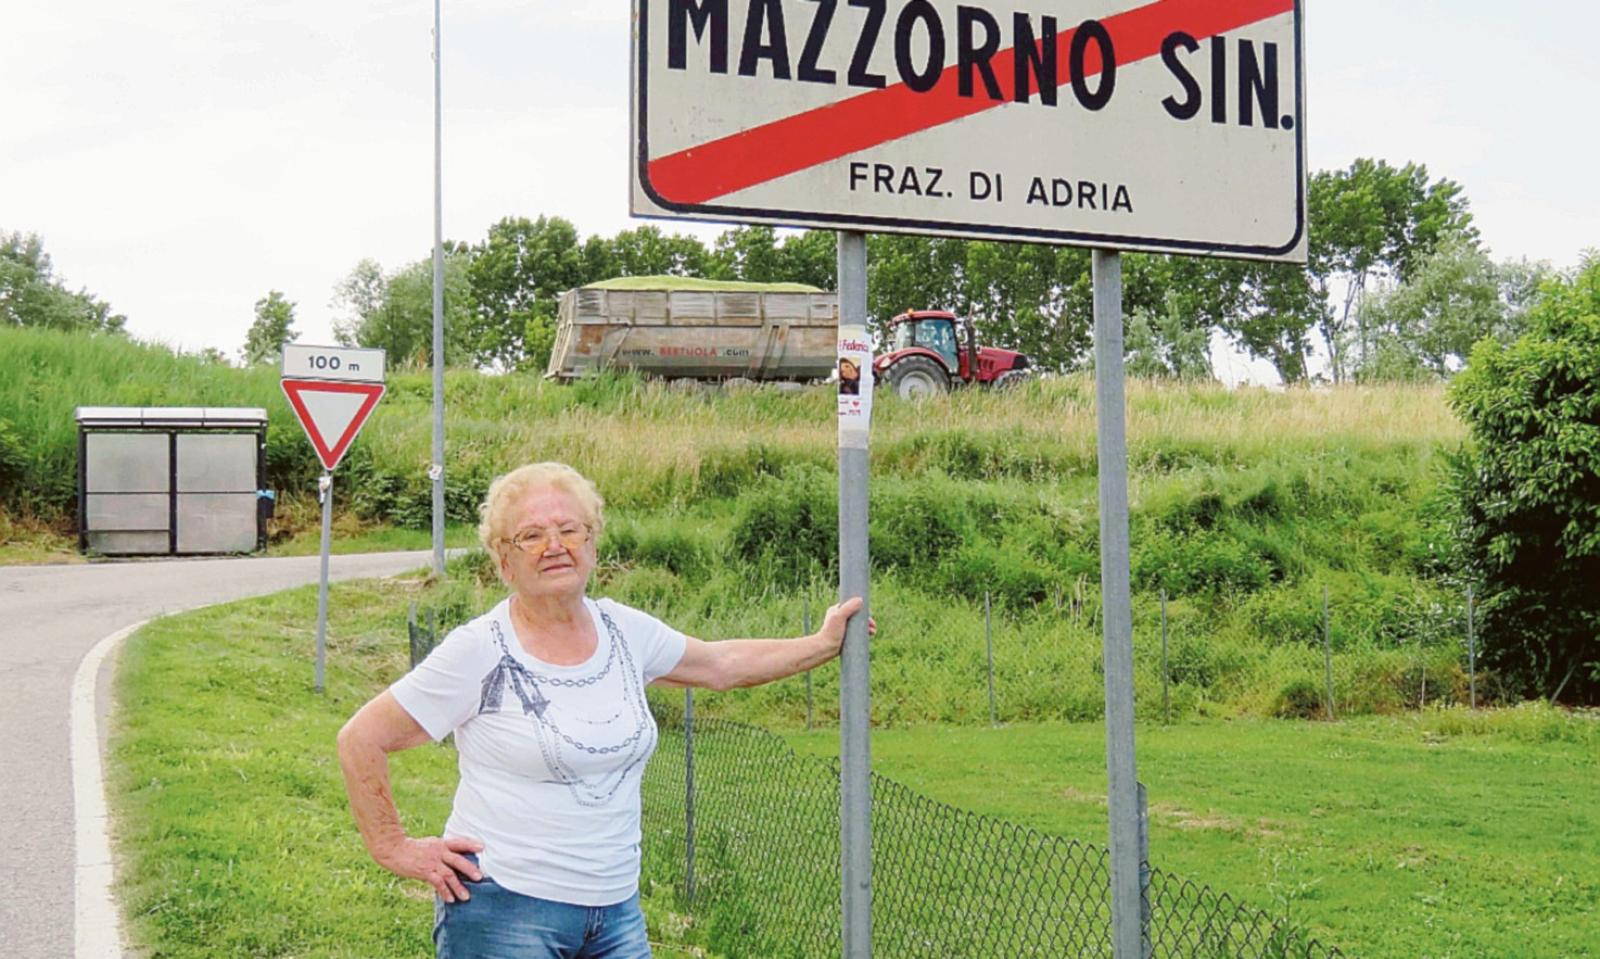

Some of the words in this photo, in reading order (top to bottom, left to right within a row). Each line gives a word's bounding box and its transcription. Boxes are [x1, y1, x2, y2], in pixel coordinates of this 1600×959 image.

[667, 0, 1117, 112] MAZZORNO
[1161, 31, 1294, 130] SIN.
[849, 162, 953, 199] FRAZ.
[969, 172, 1003, 203] DI
[1027, 177, 1133, 213] ADRIA
[308, 355, 341, 370] 100
[348, 362, 360, 372] m
